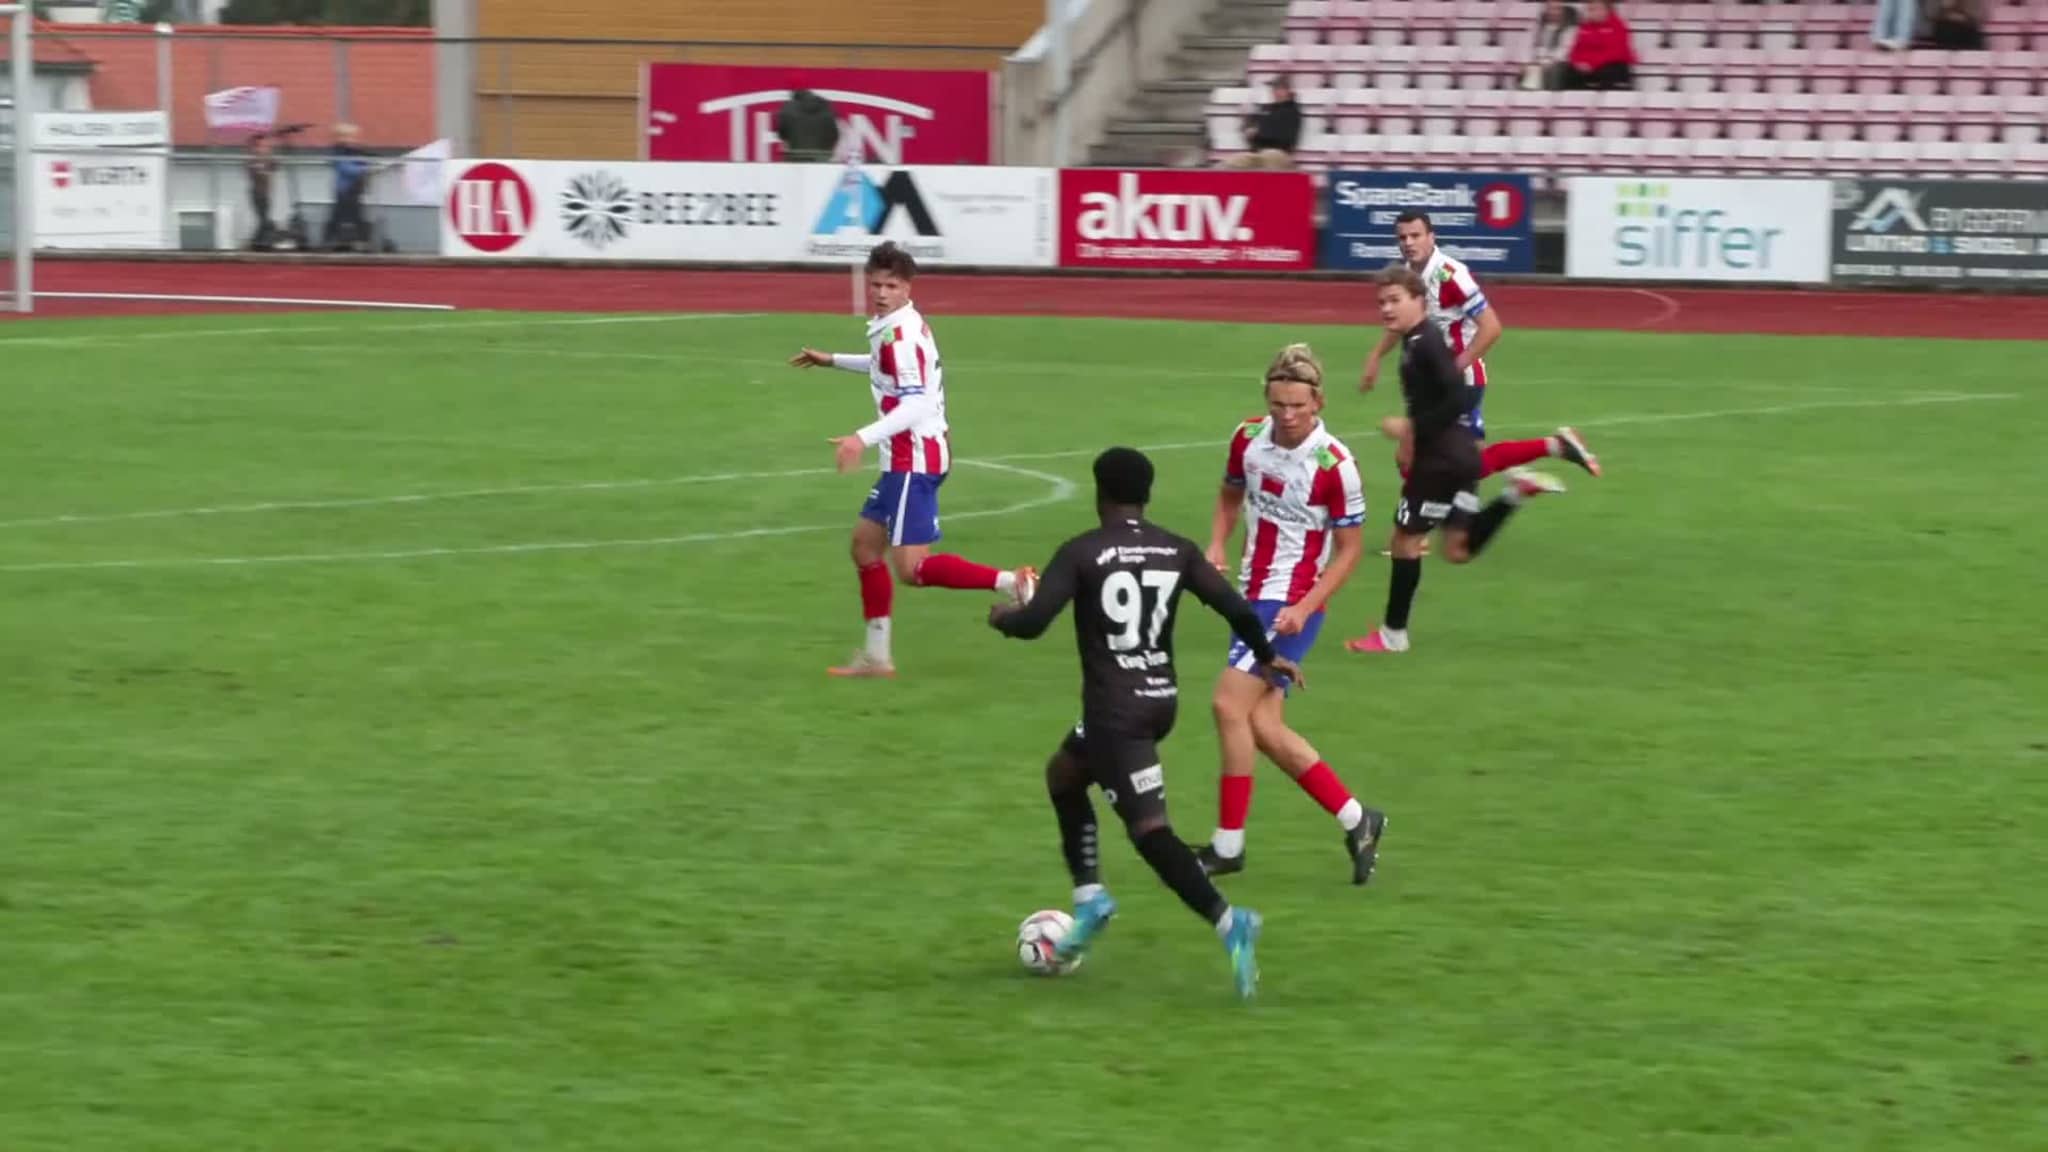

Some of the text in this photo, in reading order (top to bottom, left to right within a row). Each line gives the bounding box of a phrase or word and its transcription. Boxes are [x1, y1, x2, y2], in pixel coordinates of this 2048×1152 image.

[455, 179, 527, 236] HA
[641, 191, 781, 227] BEE2BEE
[1335, 181, 1511, 220] SpareBank 1
[1615, 203, 1785, 268] siffer
[1101, 570, 1181, 651] 97
